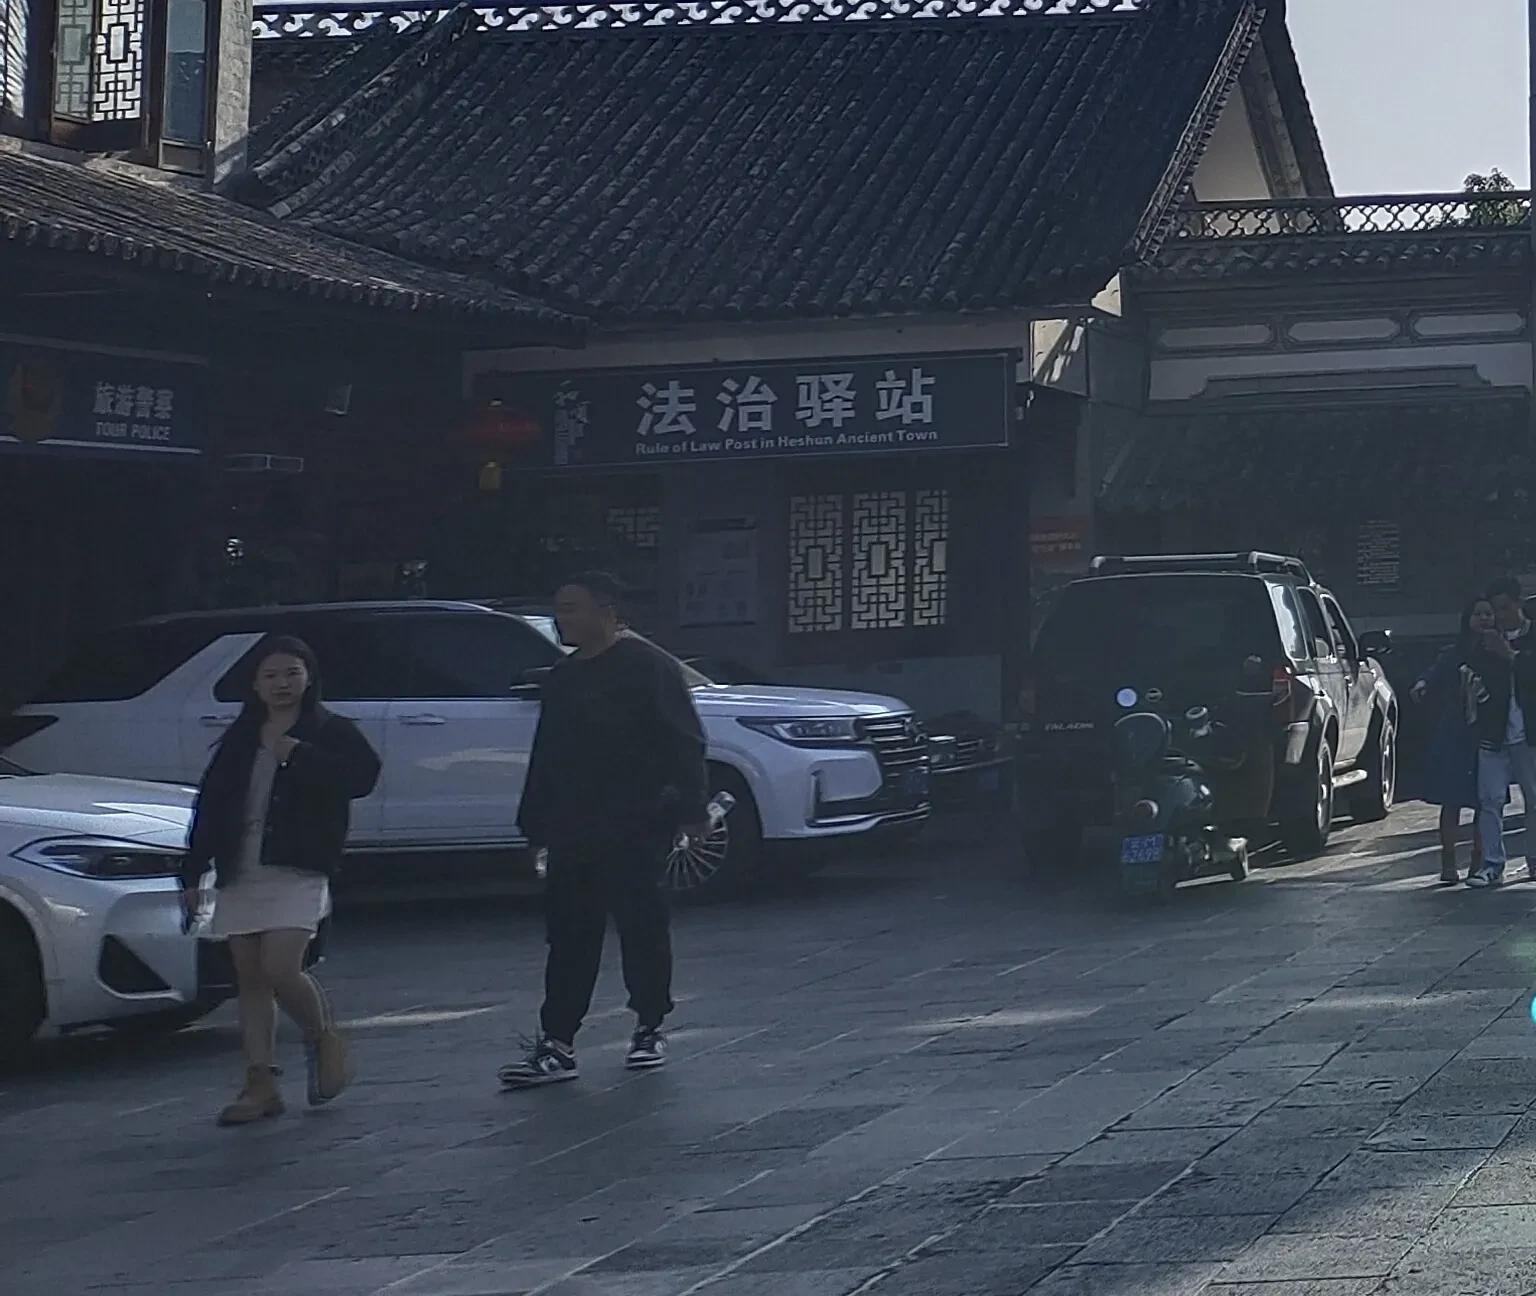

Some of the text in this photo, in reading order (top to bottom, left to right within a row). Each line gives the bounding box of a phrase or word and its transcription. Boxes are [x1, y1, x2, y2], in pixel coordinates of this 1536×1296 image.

[635, 368, 938, 436] 法治驿站
[131, 423, 172, 441] POLICE
[635, 429, 938, 455] Rule of Law Post in Heshun Ancient Town
